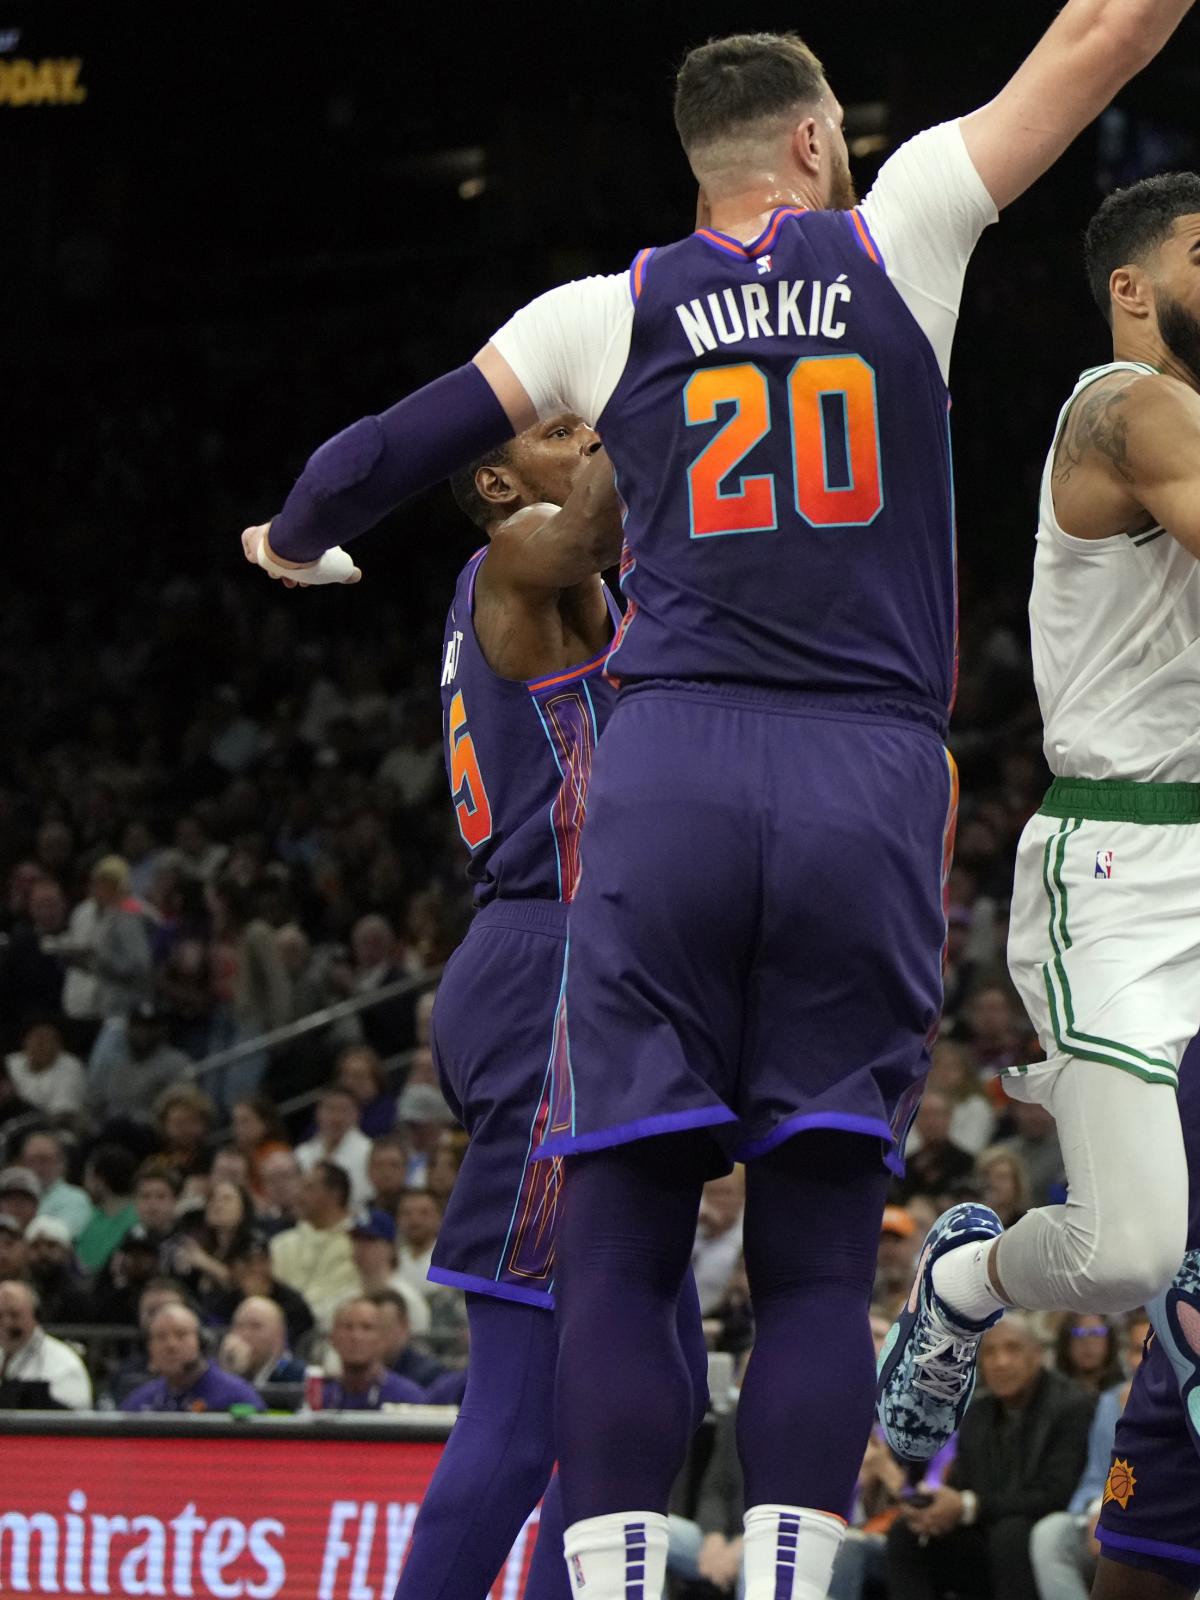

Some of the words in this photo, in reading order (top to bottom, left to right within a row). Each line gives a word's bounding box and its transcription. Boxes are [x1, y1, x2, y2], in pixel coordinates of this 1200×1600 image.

[675, 274, 852, 357] NURKIĆ
[683, 353, 884, 538] 20
[0, 1489, 285, 1598] mirates
[318, 1500, 421, 1600] FLY
